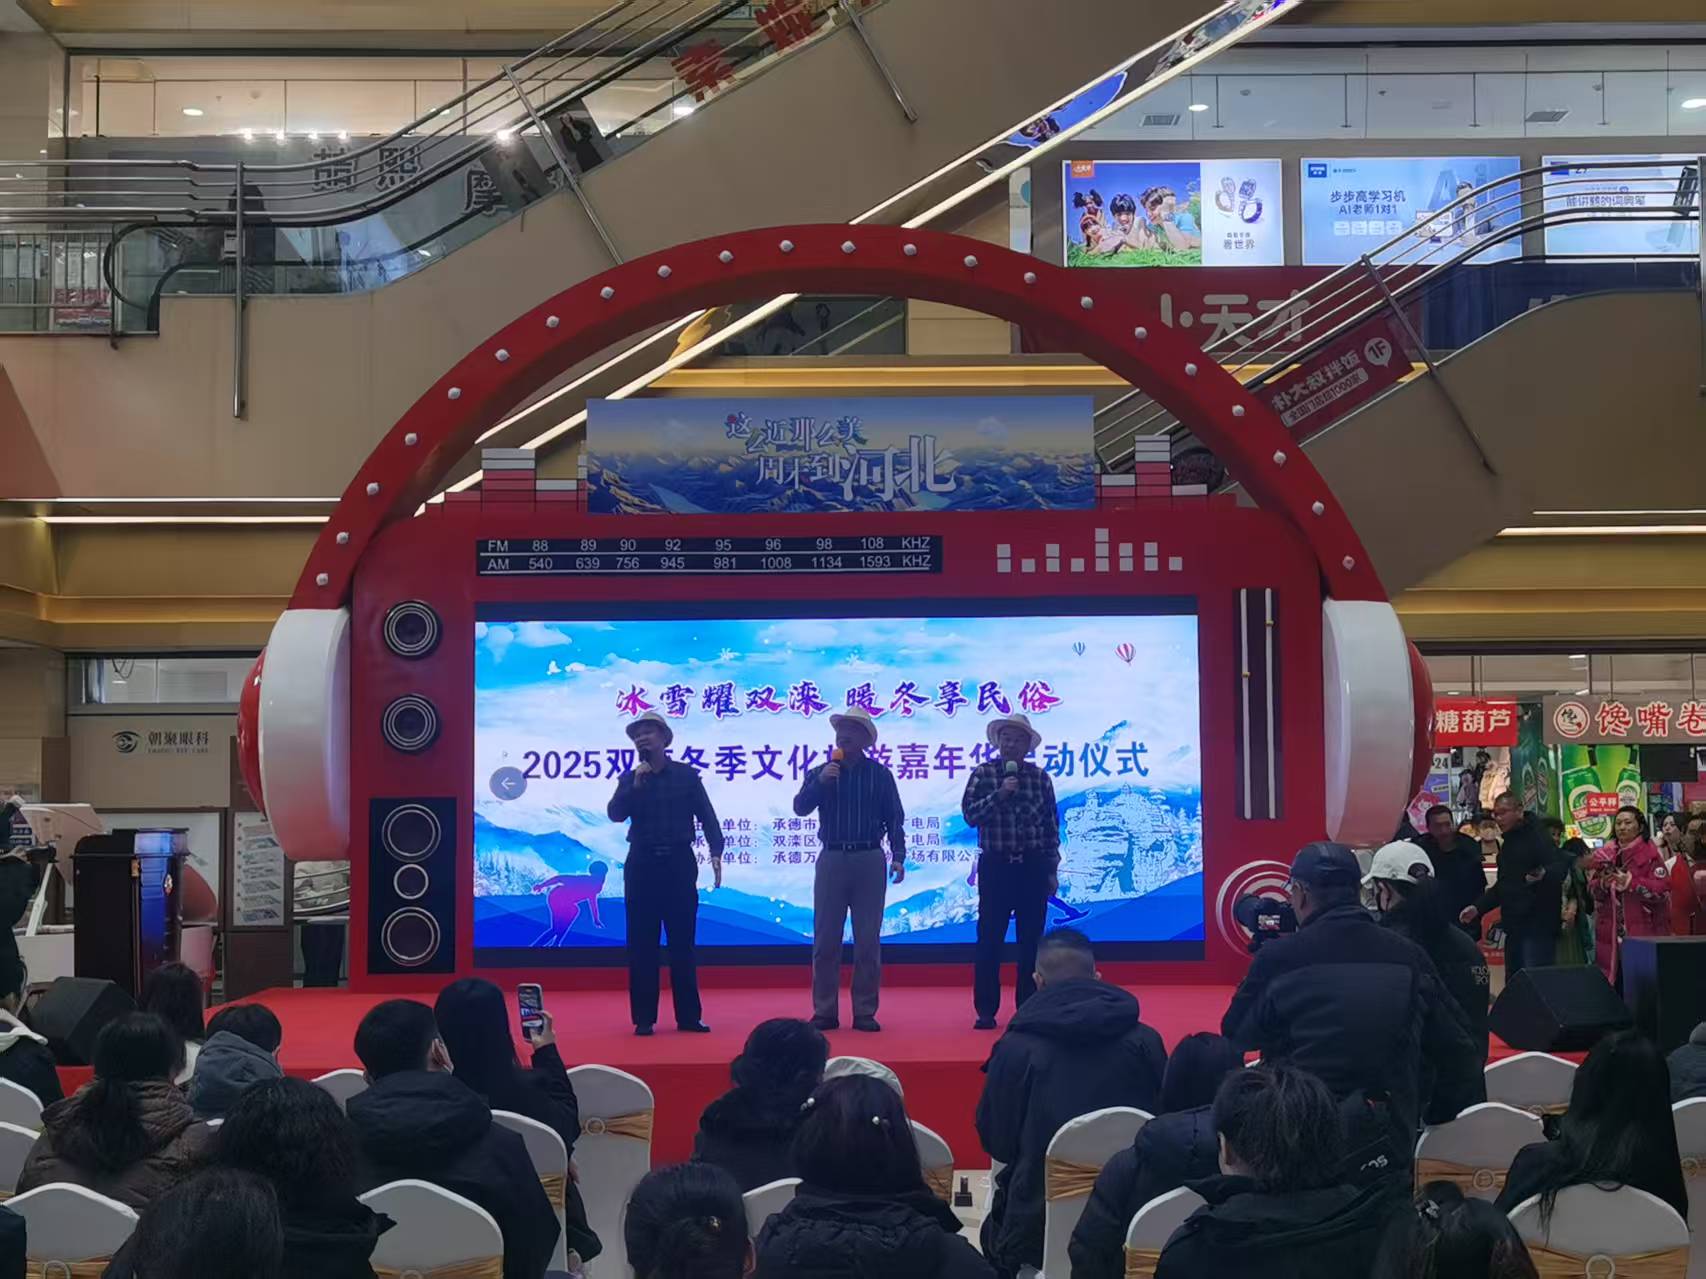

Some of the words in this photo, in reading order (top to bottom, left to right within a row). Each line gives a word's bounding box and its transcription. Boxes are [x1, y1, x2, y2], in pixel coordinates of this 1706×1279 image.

[1330, 190, 1406, 204] 步步高学习机
[1368, 341, 1387, 359] 1F
[756, 434, 957, 503] 周末到河北
[488, 540, 509, 552] FM
[532, 540, 549, 552] 88
[580, 539, 597, 551] 89
[620, 539, 636, 551] 90
[665, 539, 682, 551] 92
[715, 539, 732, 551] 95
[765, 539, 782, 550] 96
[816, 538, 833, 550] 98
[861, 537, 885, 549] 108
[902, 536, 931, 549] KHZ
[487, 558, 510, 570] AM
[528, 558, 553, 569] 540
[575, 557, 601, 569] 639
[616, 558, 640, 569] 756
[660, 557, 685, 569] 945
[713, 557, 737, 569] 981
[761, 557, 792, 569] 1008
[812, 556, 842, 568] 1134
[860, 555, 891, 568] 1593
[902, 555, 932, 567] KHZ
[615, 680, 830, 720] 冰雪耀双滦
[845, 680, 1063, 718] 暖冬享民俗
[1436, 708, 1512, 734] 糖葫芦
